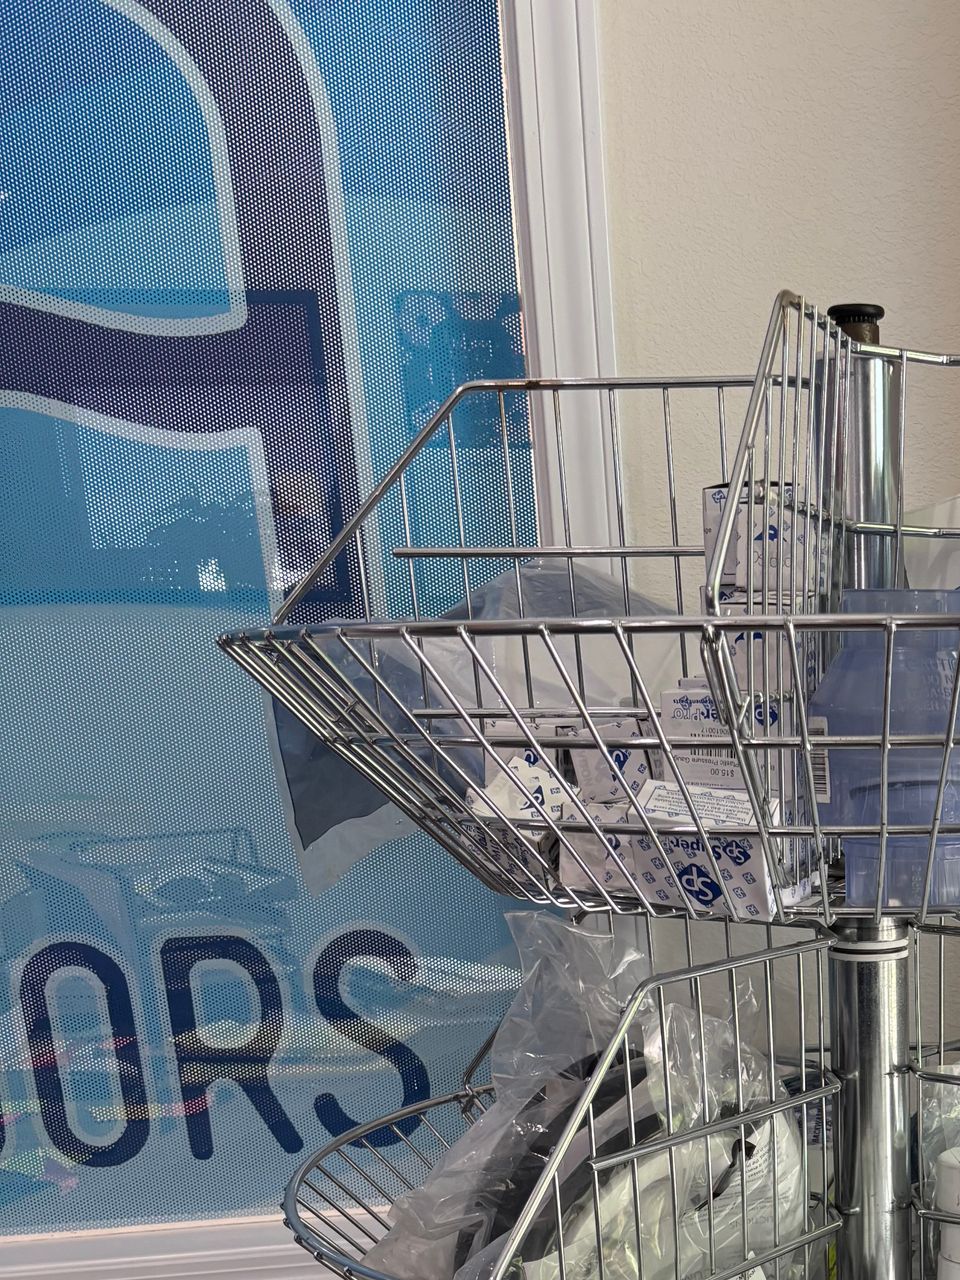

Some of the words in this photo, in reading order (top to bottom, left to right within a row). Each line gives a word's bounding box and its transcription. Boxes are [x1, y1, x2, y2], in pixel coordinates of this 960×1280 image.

[710, 768, 735, 777] $15.00
[681, 866, 714, 902] SP
[0, 929, 431, 1168] ORS
